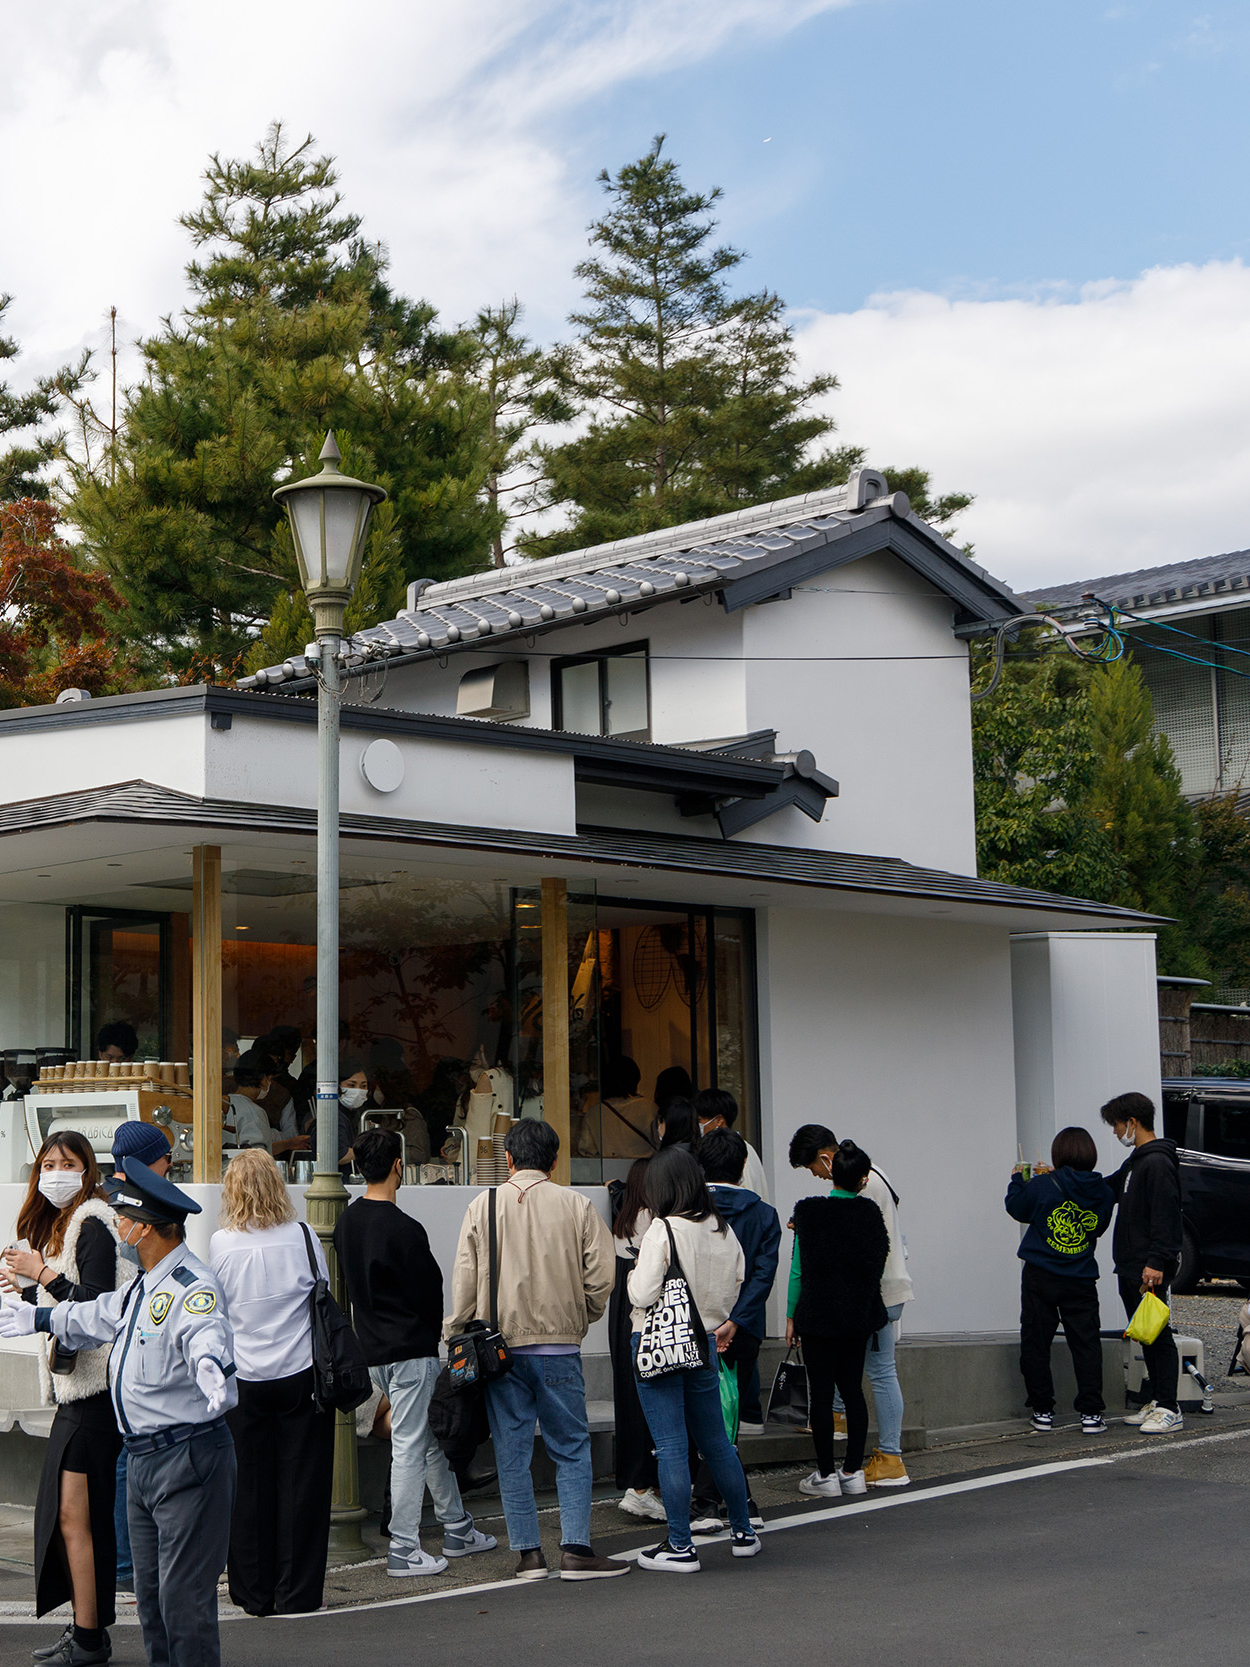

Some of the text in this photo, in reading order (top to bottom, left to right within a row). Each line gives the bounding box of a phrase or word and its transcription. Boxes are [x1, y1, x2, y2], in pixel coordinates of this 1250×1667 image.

[664, 1278, 687, 1292] ERGY
[641, 1303, 691, 1336] FROM
[683, 1341, 698, 1352] THE
[637, 1344, 686, 1372] DOM
[684, 1350, 700, 1362] NET
[640, 1368, 663, 1378] COMME
